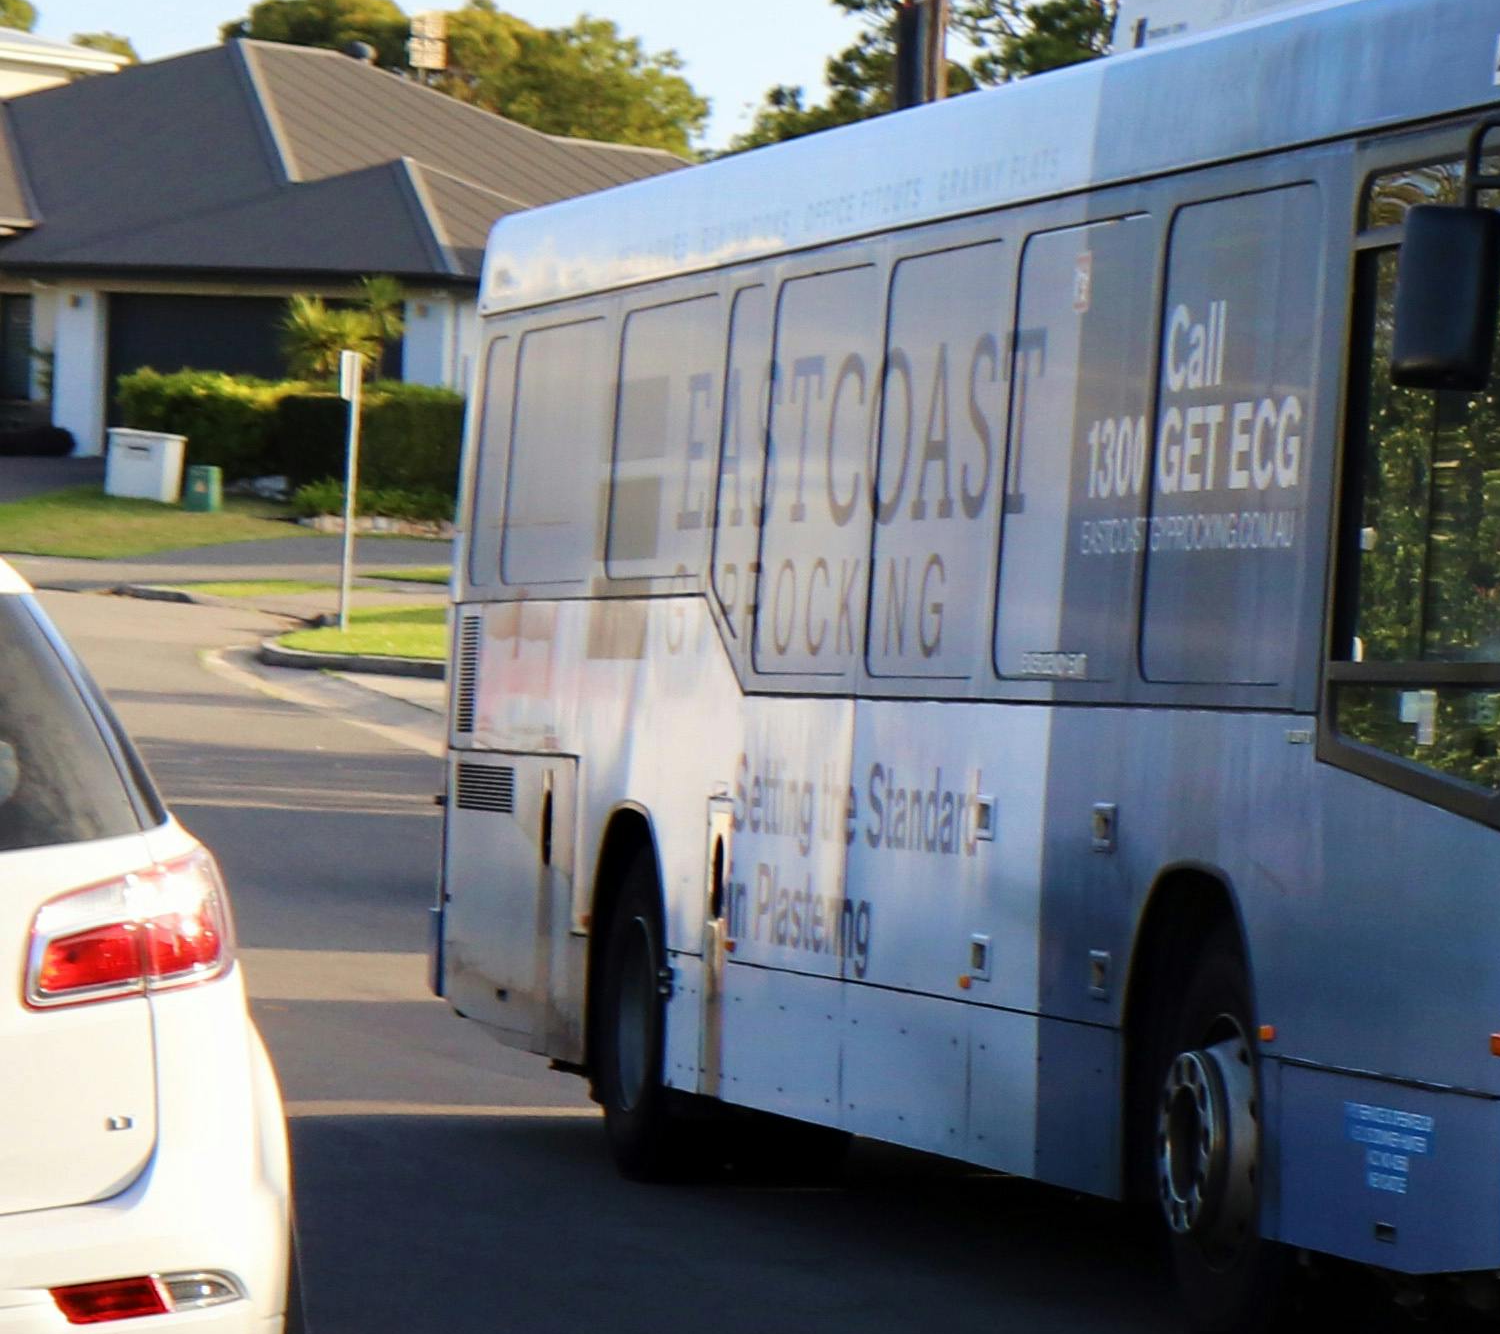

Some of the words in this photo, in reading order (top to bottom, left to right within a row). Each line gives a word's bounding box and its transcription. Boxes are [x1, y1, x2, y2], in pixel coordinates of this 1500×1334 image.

[1167, 299, 1227, 392] Call
[676, 327, 1047, 530] EASTCOAST
[1088, 415, 1148, 499] 1300
[1158, 404, 1226, 496] GET
[1228, 394, 1302, 490] ECG
[732, 751, 814, 858] Setting
[822, 761, 858, 847] the
[866, 761, 981, 857] Standard
[754, 862, 872, 979] Plastering
